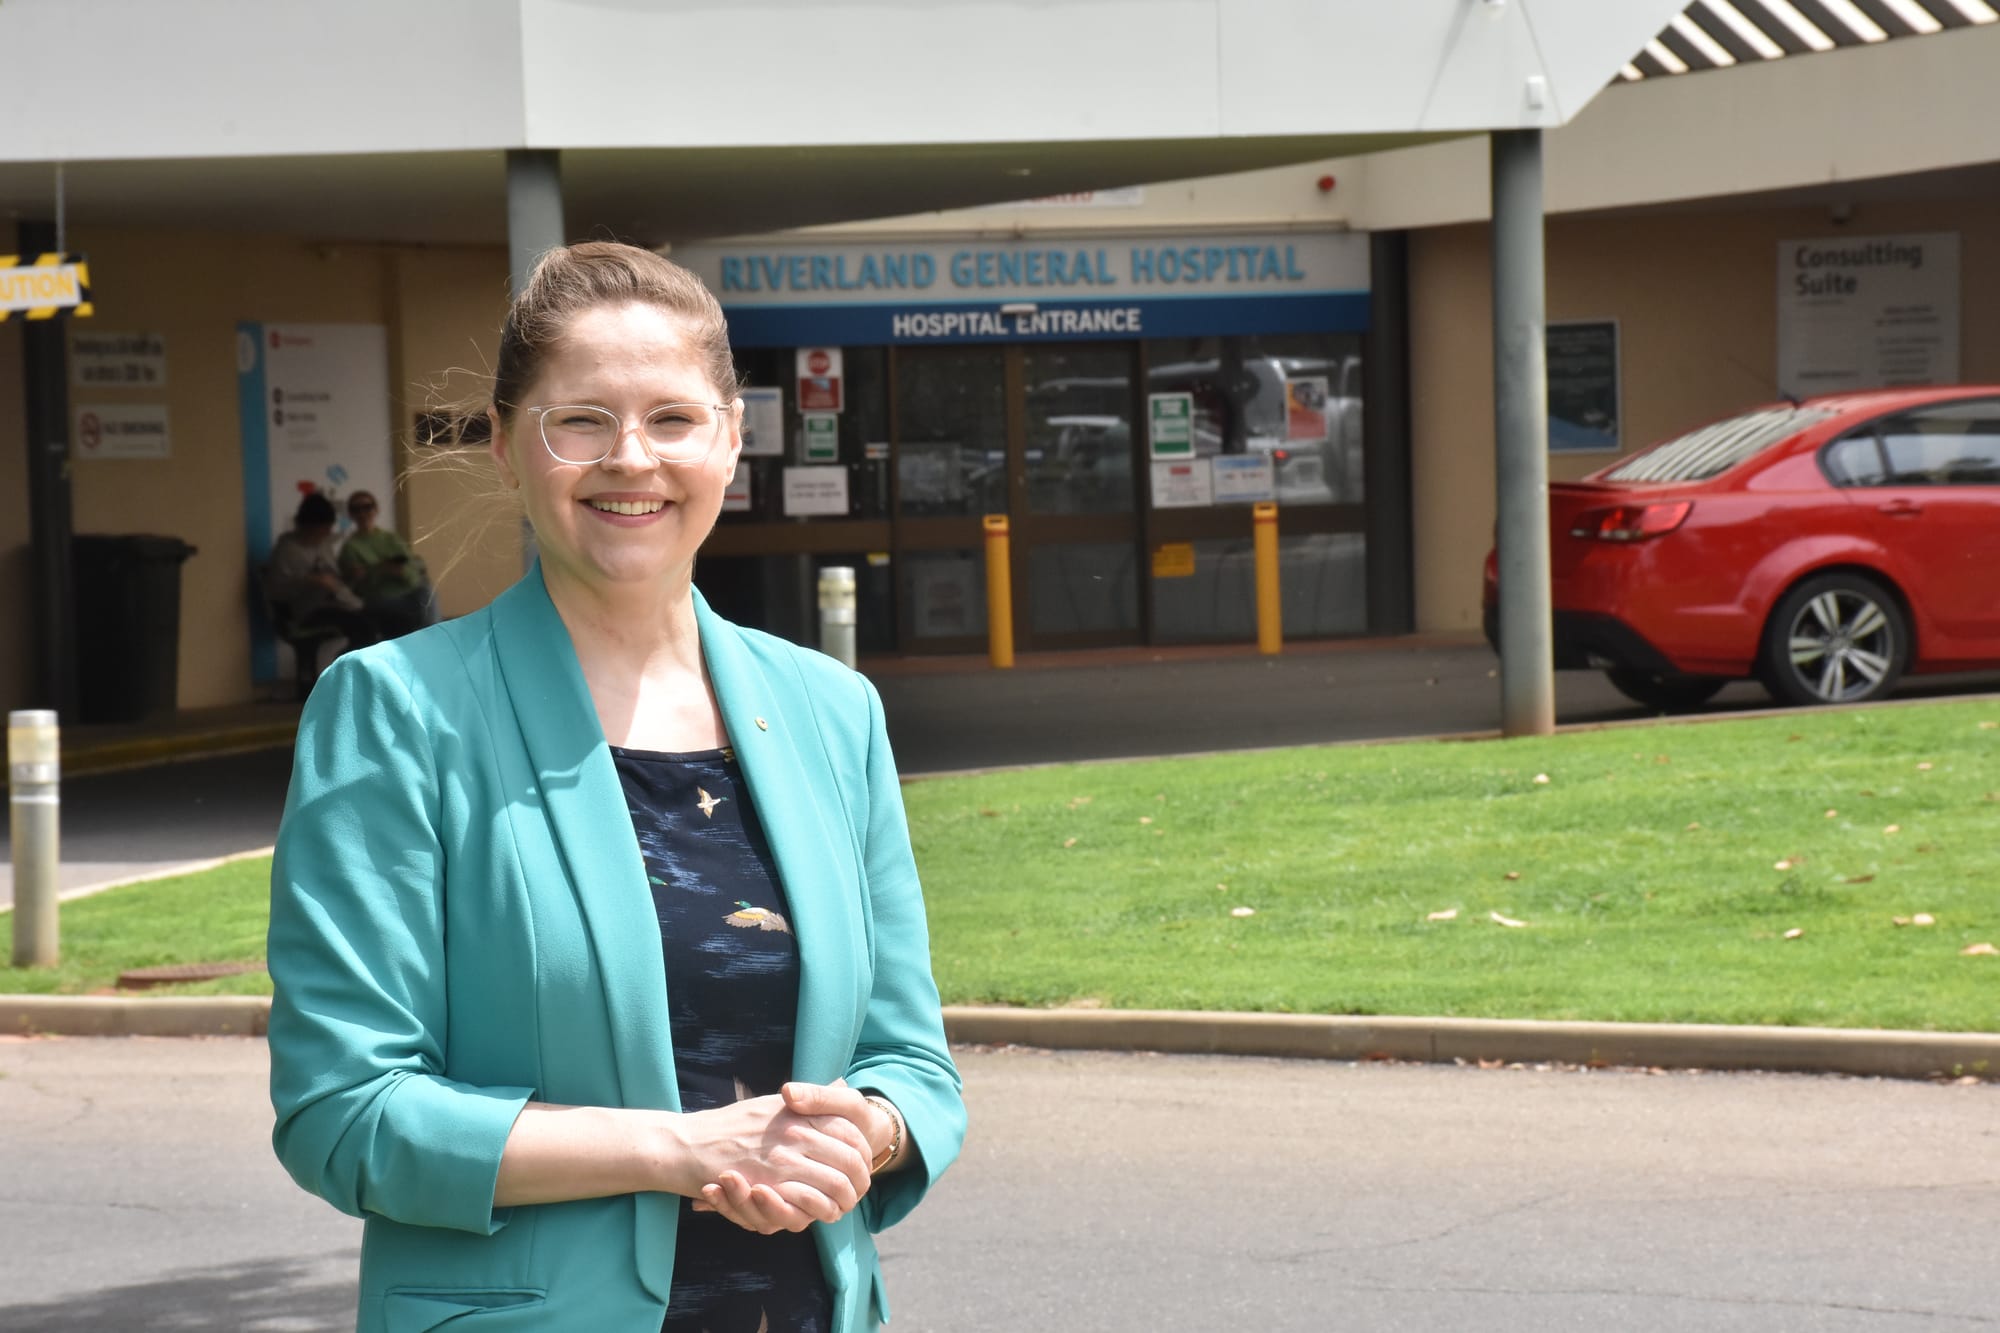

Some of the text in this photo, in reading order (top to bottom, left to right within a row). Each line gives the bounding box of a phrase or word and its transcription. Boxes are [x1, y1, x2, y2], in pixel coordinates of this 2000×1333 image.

[721, 244, 1306, 291] RIVERLAND GENERAL HOSPITAL
[1796, 241, 1922, 269] Consulting
[1796, 272, 1857, 295] Suite
[893, 307, 1142, 336] HOSPITAL ENTRANCE
